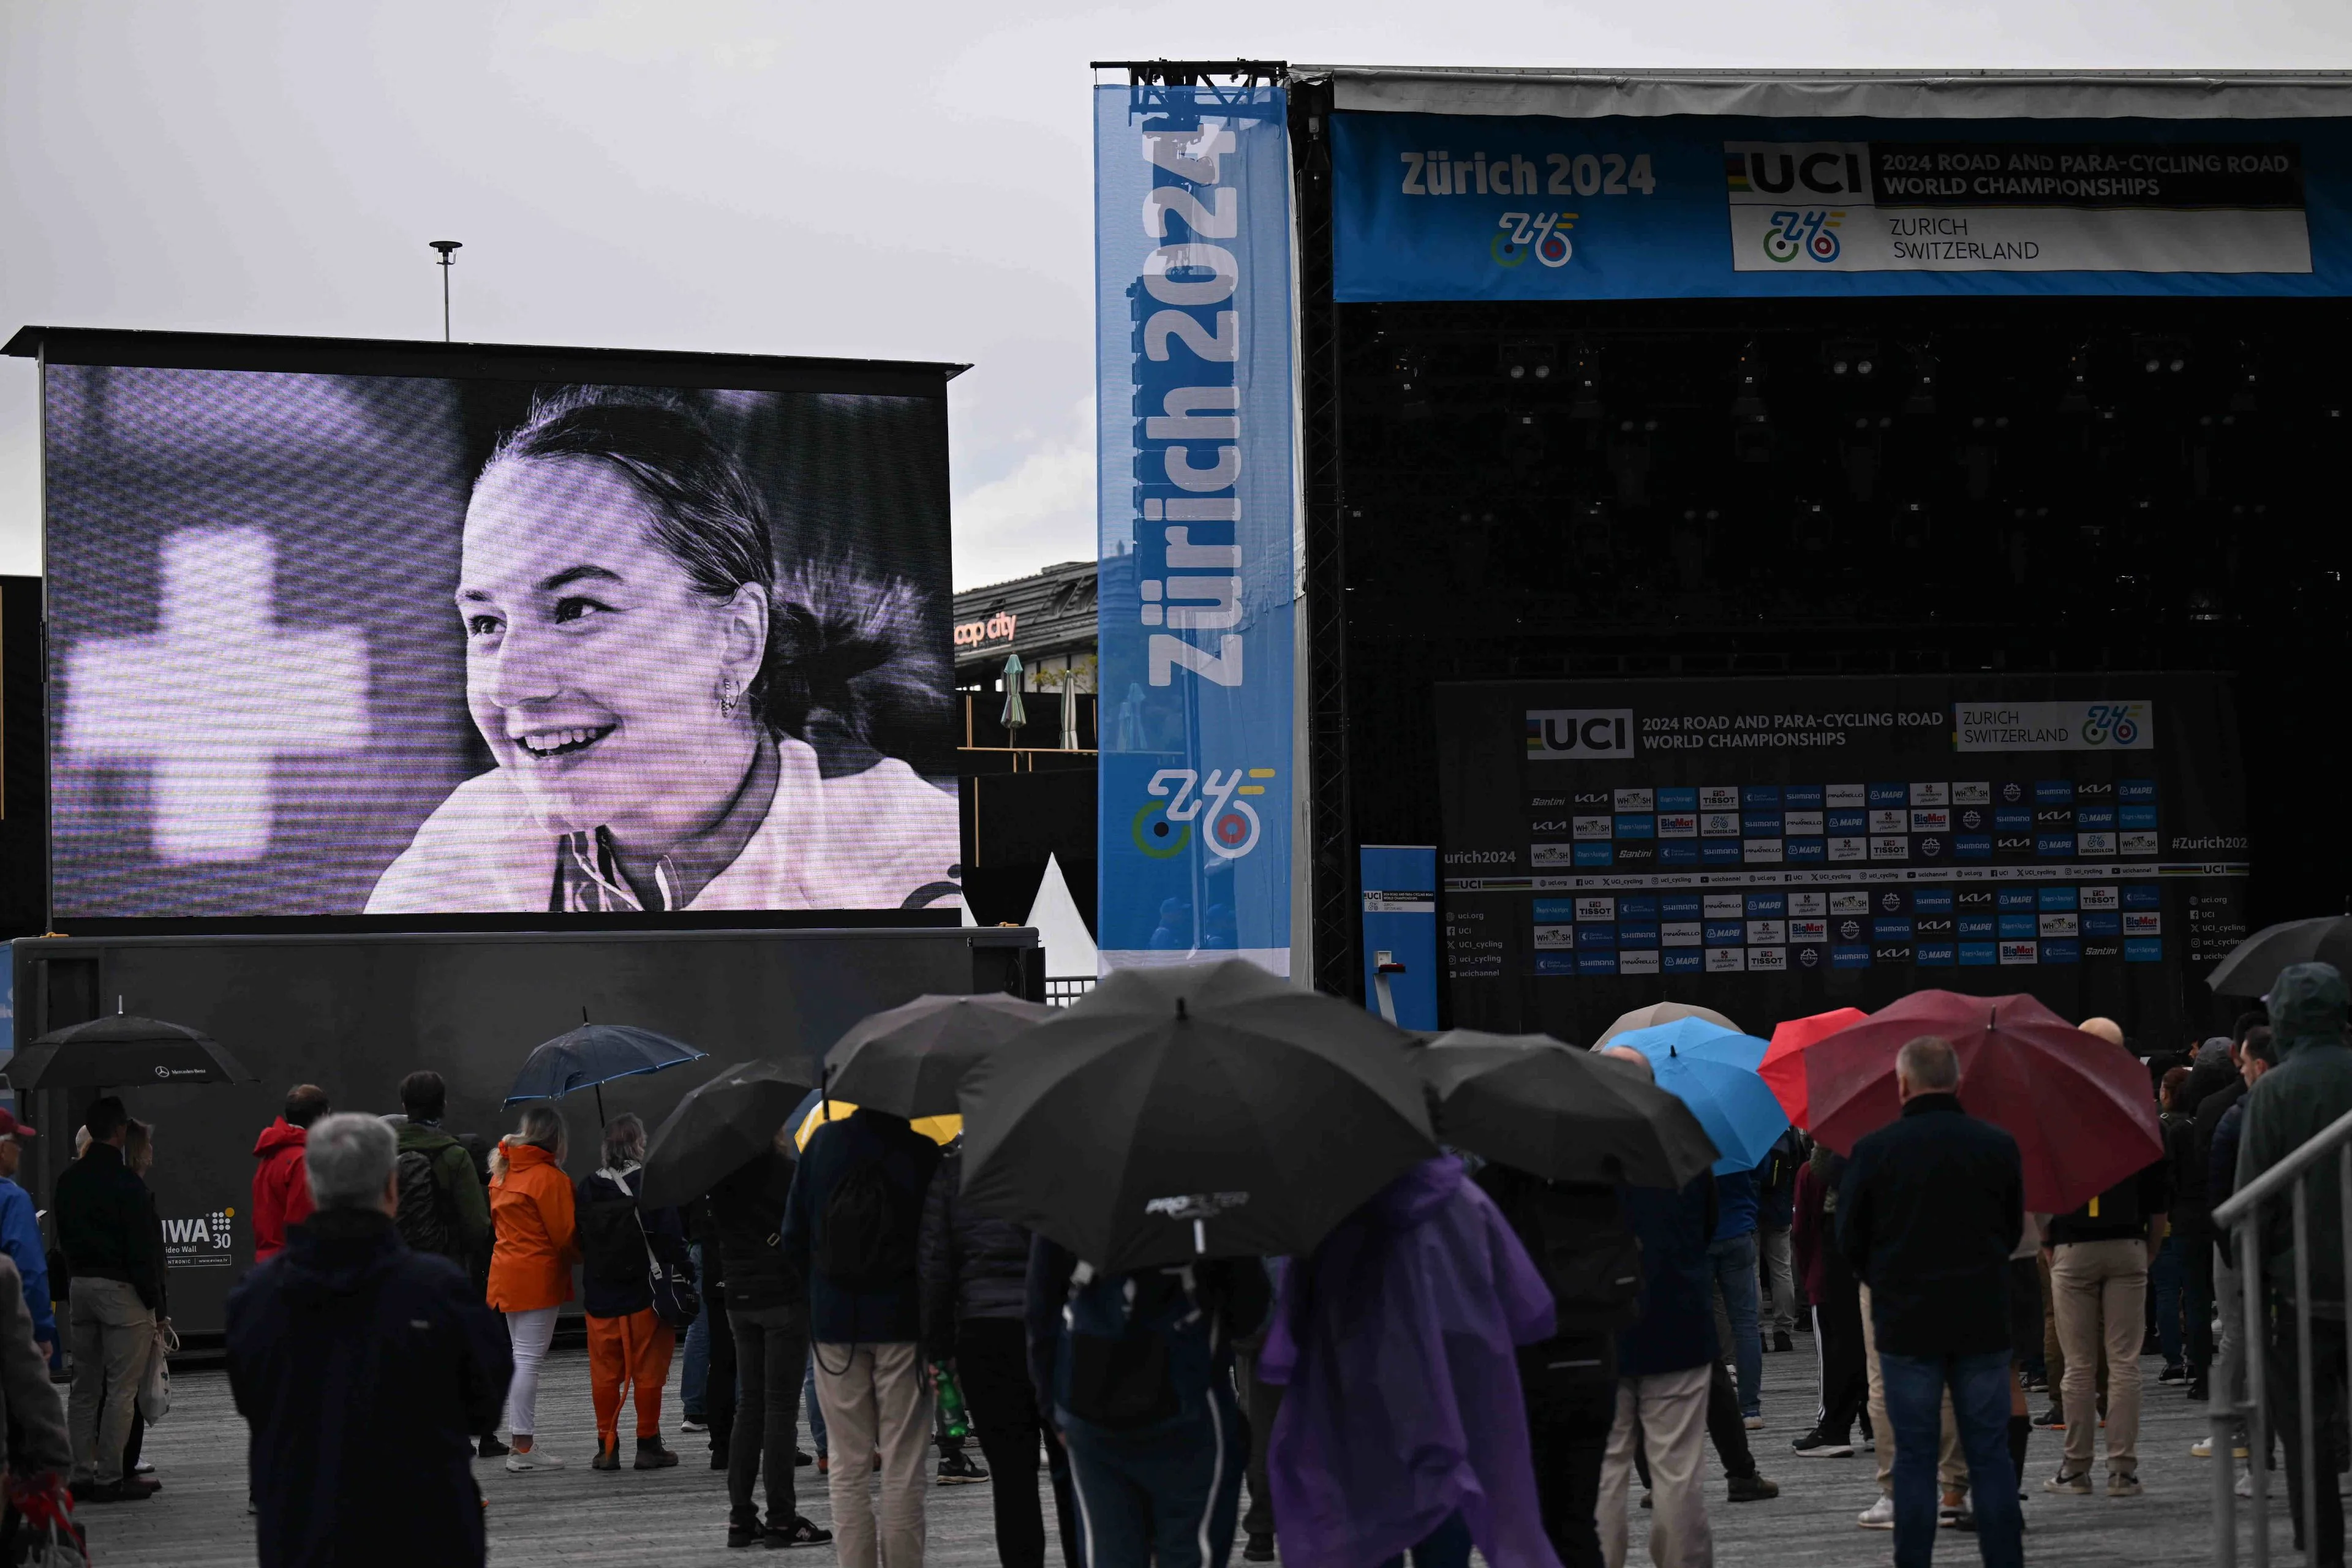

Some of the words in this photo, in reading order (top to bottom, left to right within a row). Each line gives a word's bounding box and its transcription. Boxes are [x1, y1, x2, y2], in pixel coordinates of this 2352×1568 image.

[1882, 154, 1932, 172] 2024
[1937, 153, 2000, 172] ROAD
[2008, 153, 2054, 172] AND
[2060, 155, 2222, 173] PARA-CYCLING
[2228, 156, 2288, 173] ROAD
[1400, 151, 1537, 196] Zürich
[1547, 153, 1656, 195] 2024
[1751, 151, 1863, 194] UCI
[1883, 178, 1967, 195] WORLD
[1973, 178, 2160, 196] CHAMPIONSHIPS
[1890, 219, 1968, 236] ZURICH
[1142, 117, 1239, 363] 2024
[1894, 242, 2039, 260] SWITZERLAND
[1141, 383, 1243, 687] Zürich
[987, 611, 1017, 641] city
[1643, 717, 1679, 731] 2024
[1684, 716, 1730, 729] ROAD
[1734, 715, 1767, 729] AND
[1774, 714, 1893, 728] PARA-CYCLING
[1898, 712, 1943, 726] ROAD
[1964, 711, 2019, 725] ZURICH
[1545, 718, 1625, 750] UCI
[1643, 735, 1703, 749] WORLD
[1708, 733, 1846, 748] CHAMPIONSHIPS
[1965, 729, 2068, 744] SWITZERLAND
[1532, 797, 1566, 806] Santini
[1881, 791, 1903, 799] MAPEI
[1661, 818, 1694, 827] BigMat
[1914, 813, 1946, 823] BigMat
[1619, 850, 1653, 858] Santini
[1792, 923, 1824, 932] BigMat
[2126, 916, 2157, 925] BigMat
[1717, 929, 1740, 937] MAPEI
[2002, 946, 2034, 955] BigMat
[2085, 946, 2117, 955] Santini
[213, 1234, 231, 1248] 30
